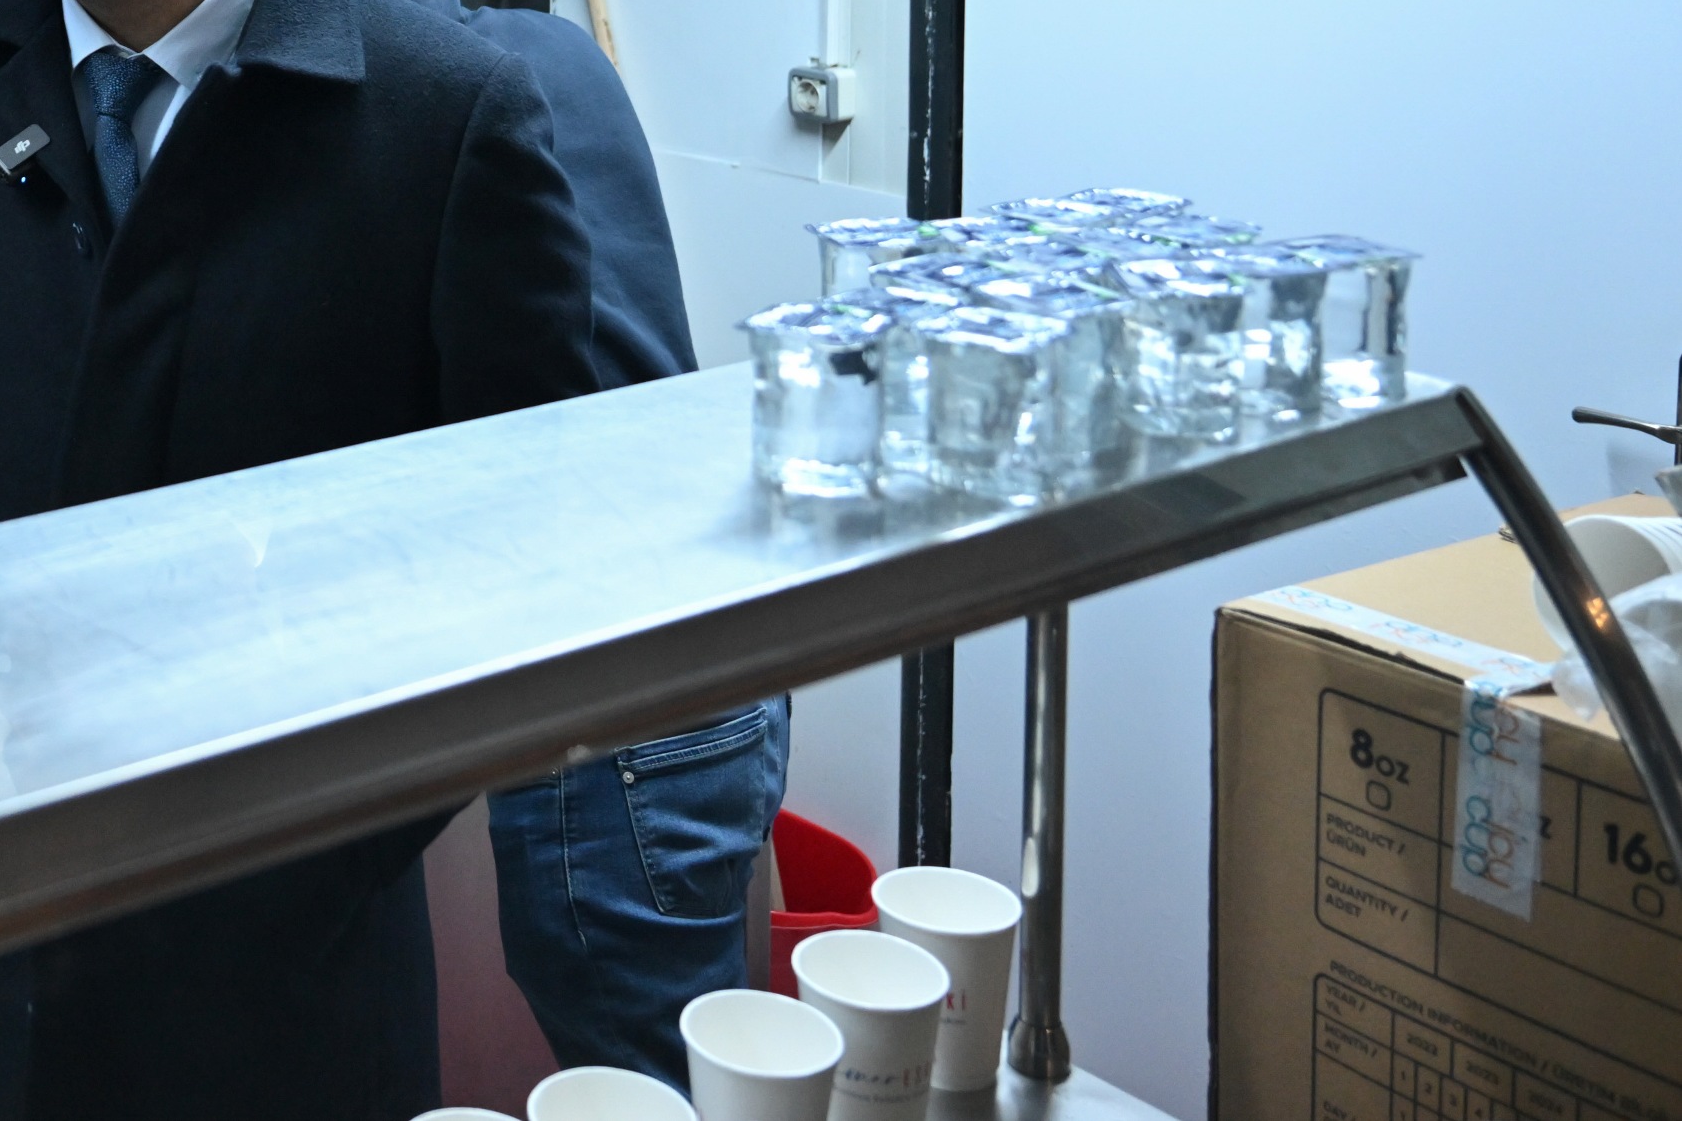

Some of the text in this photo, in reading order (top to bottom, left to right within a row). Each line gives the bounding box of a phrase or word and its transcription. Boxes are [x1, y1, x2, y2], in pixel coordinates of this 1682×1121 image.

[1326, 813, 1395, 851] PRODUCT
[1326, 829, 1366, 858] ÜRÜN
[1325, 876, 1398, 916] QUANTITY
[1325, 893, 1362, 918] ADET
[1325, 983, 1358, 1009] YEAR
[1330, 959, 1424, 1016] PRODUCTION
[1325, 1022, 1369, 1055] MONTH
